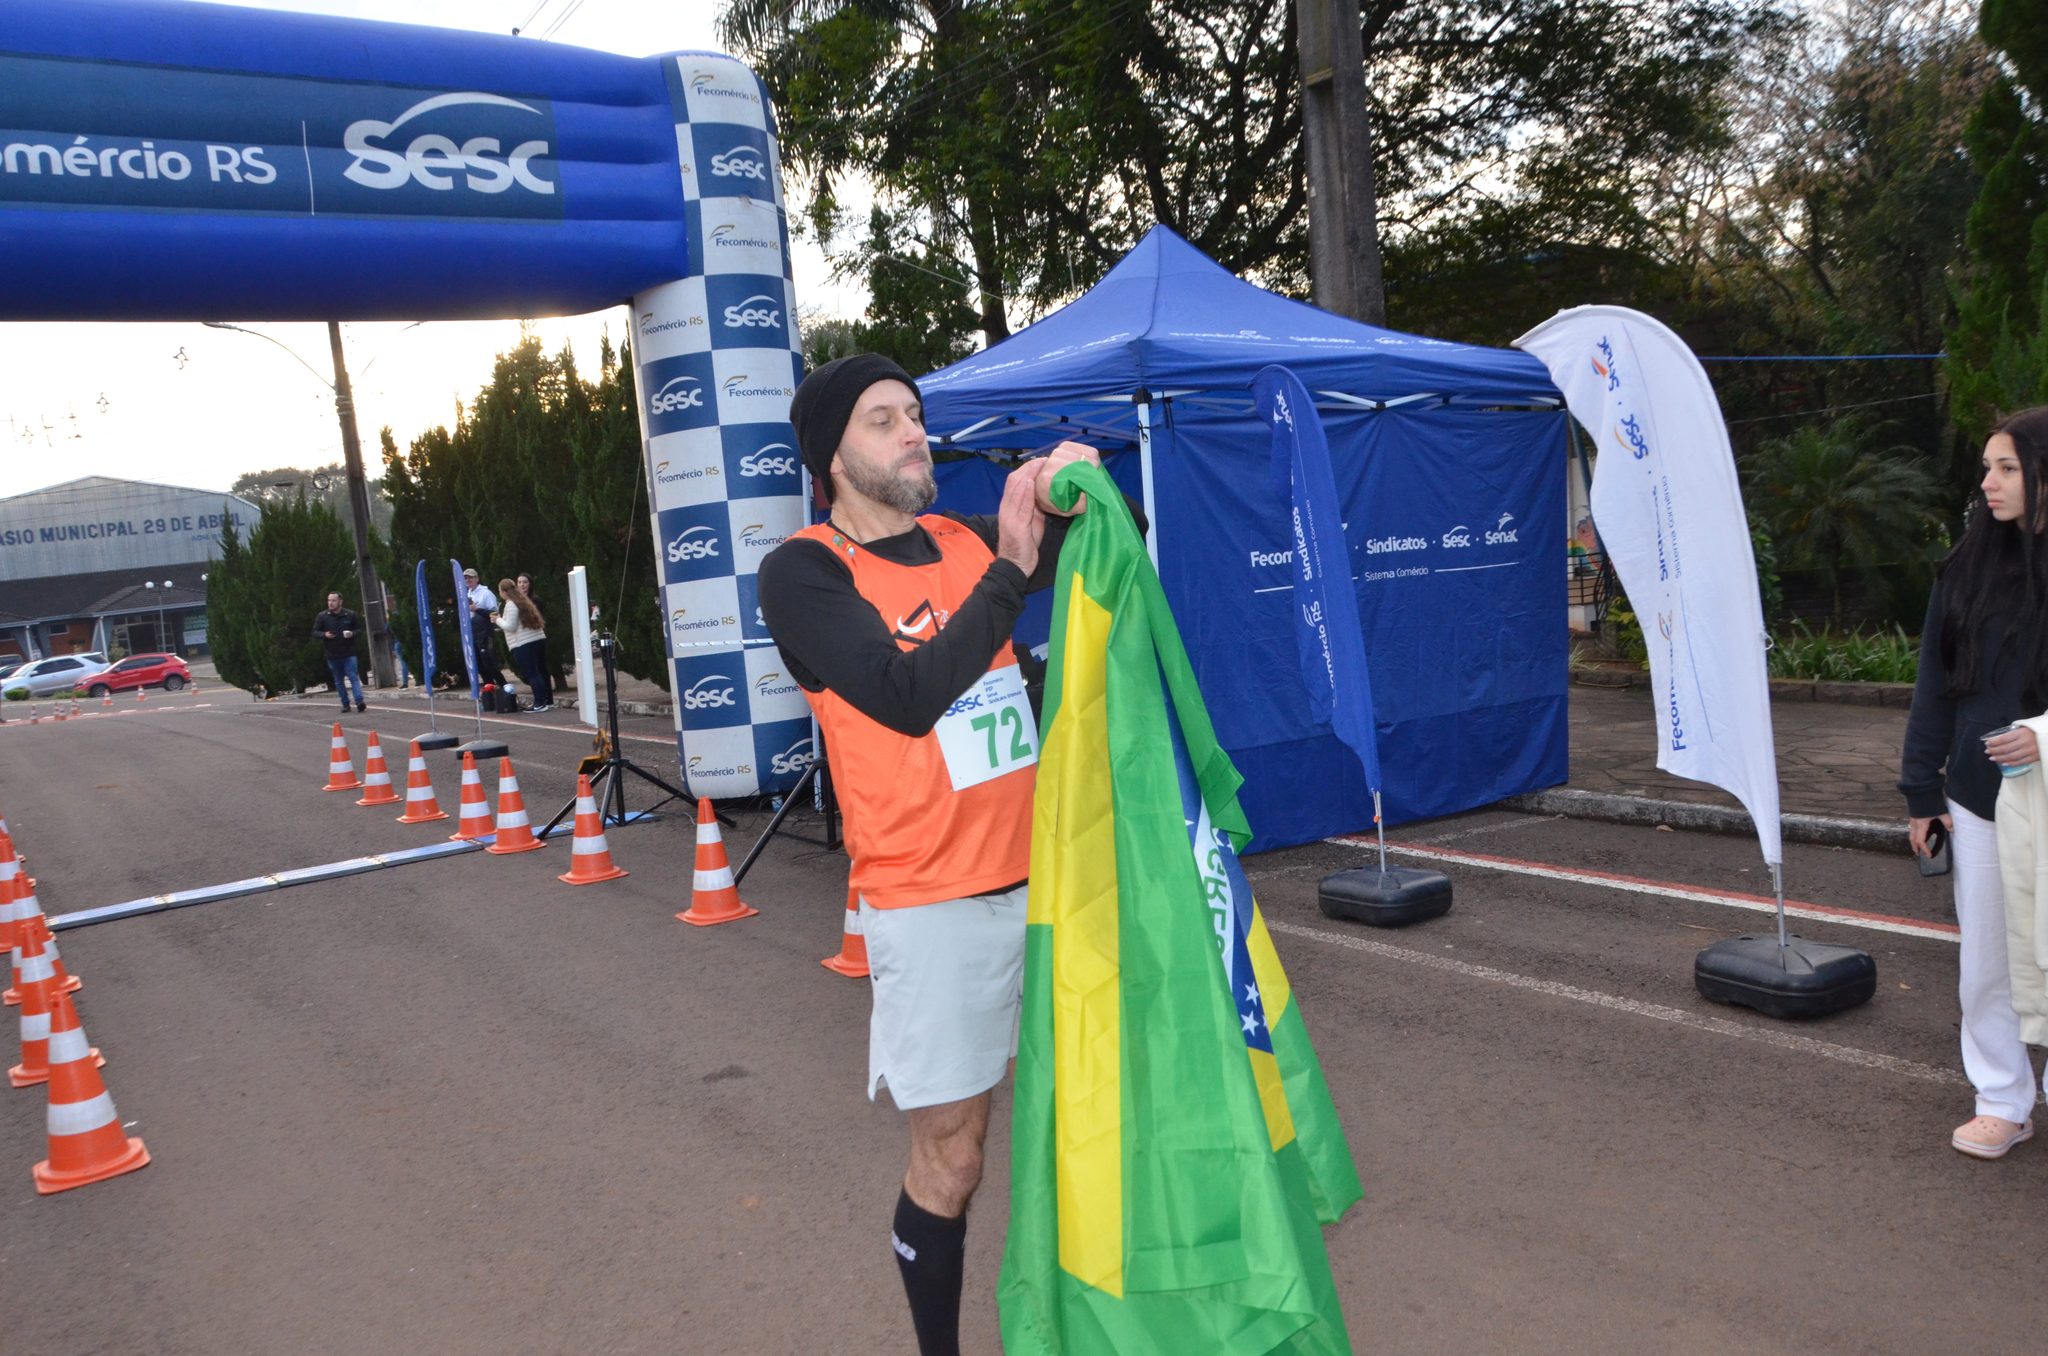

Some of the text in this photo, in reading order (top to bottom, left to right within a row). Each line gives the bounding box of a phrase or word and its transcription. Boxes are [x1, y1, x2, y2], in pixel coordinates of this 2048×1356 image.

[697, 87, 749, 101] Fecomércio
[0, 136, 277, 185] mércio RS
[343, 117, 555, 195] Sesc
[711, 152, 766, 181] Sesc
[715, 237, 768, 249] Fecomércio
[641, 316, 704, 337] Fecomércio RS
[723, 303, 781, 329] Sesc
[651, 386, 703, 415] Sesc
[729, 386, 793, 397] Fecomércio RS
[1619, 414, 1649, 460] Sesc
[657, 466, 720, 485] Fecomércio RS
[739, 454, 796, 477] Sesc
[40, 521, 138, 543] MUNICIPAL
[143, 518, 167, 534] 29
[171, 516, 192, 532] DE
[1442, 531, 1470, 548] Sesc
[1485, 528, 1518, 545] Senac
[668, 534, 719, 562] Sesc
[1292, 506, 1313, 581] Sindicatos
[1366, 536, 1427, 554] Sindicatos
[1365, 567, 1429, 582] Sistema Comércio
[1310, 601, 1323, 622] RS
[674, 616, 735, 632] Fecomércio RS
[684, 684, 735, 710] Sesc
[970, 706, 1033, 769] 72
[690, 763, 751, 778] Fecomércio RS
